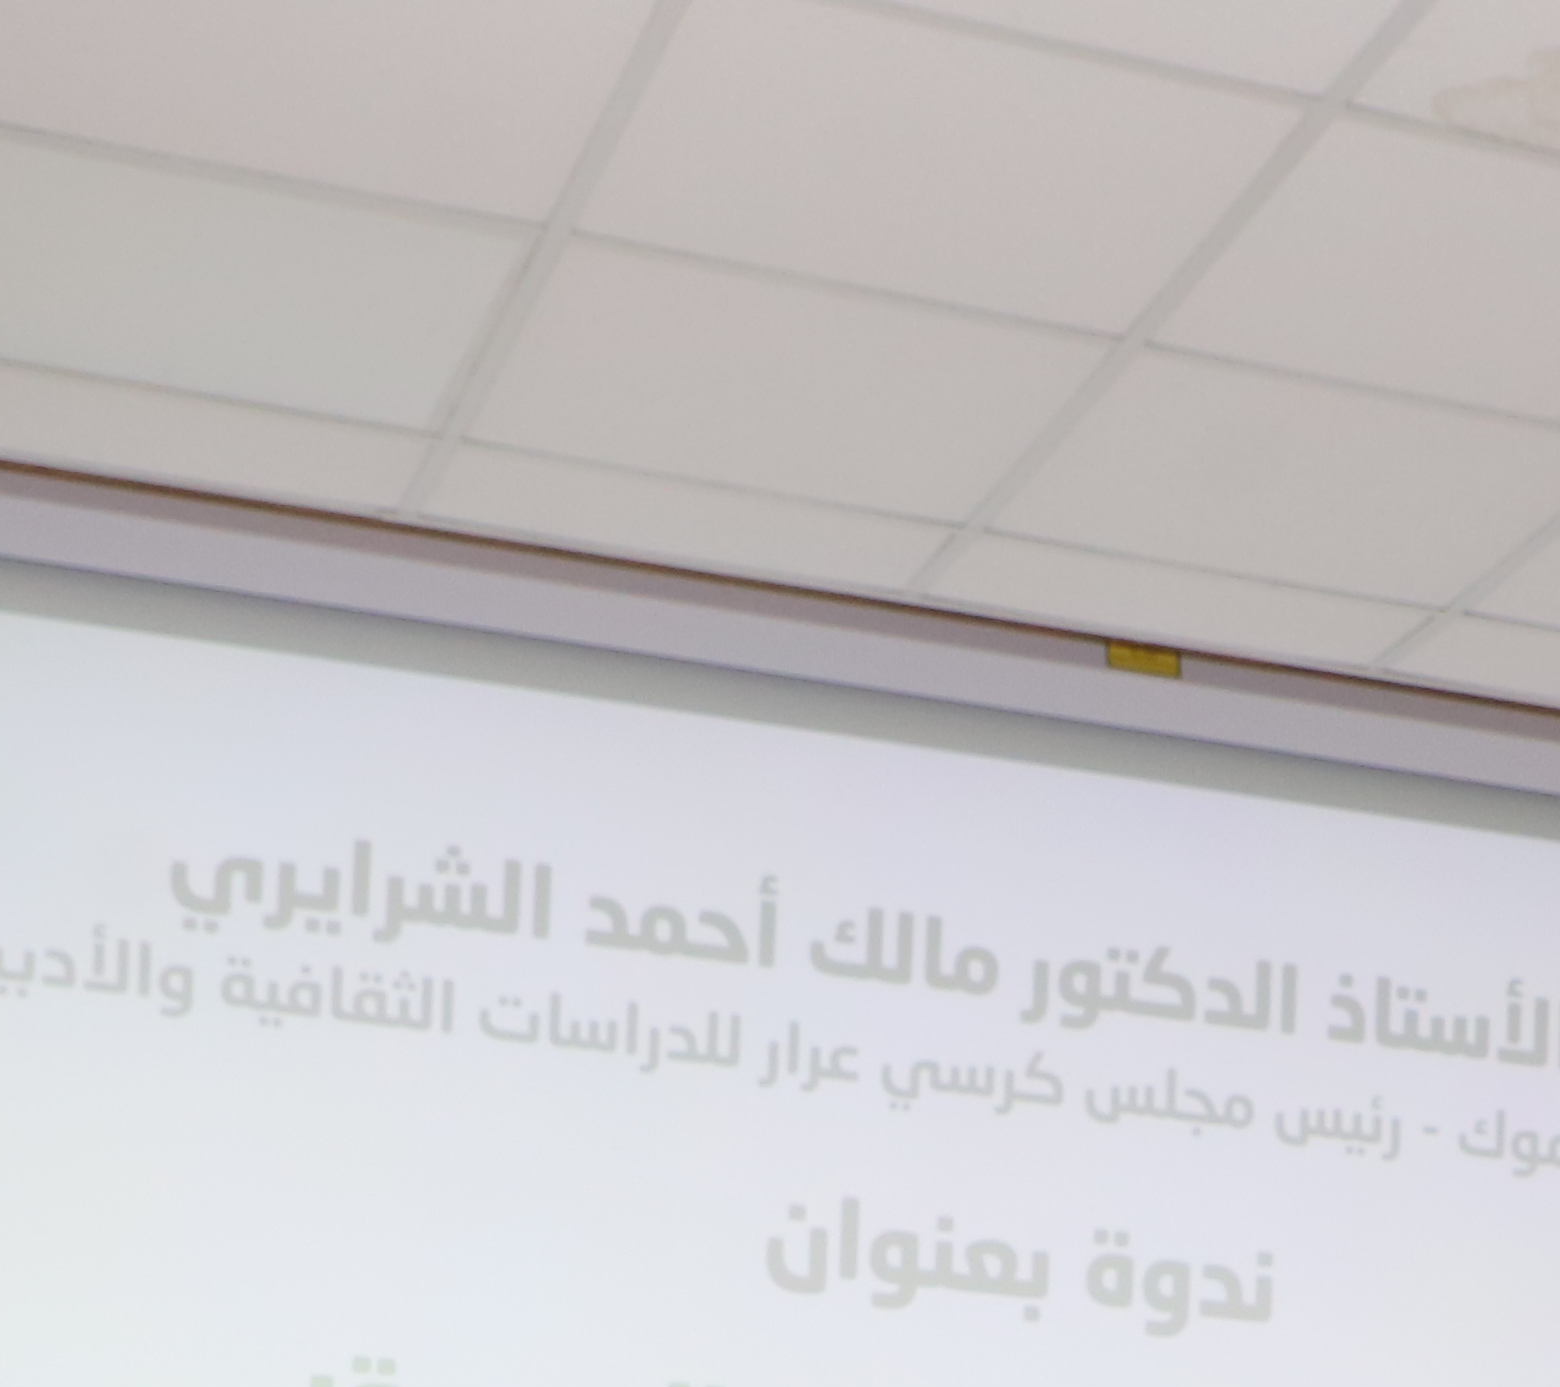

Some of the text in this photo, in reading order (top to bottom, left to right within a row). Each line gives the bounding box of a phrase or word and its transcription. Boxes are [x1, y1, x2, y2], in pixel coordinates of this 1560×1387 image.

[168, 838, 554, 945] الشرايري
[583, 872, 780, 970] أحمد
[807, 905, 1001, 996] مالك
[1017, 943, 1300, 1035] الدكتور
[219, 954, 456, 1035] الثقافية
[477, 990, 743, 1076] للدراسات
[756, 1018, 860, 1094] عرار
[879, 1032, 1065, 1117] كرسي
[1083, 1062, 1256, 1138] مجلس
[1273, 1092, 1403, 1164] رئيس
[764, 1195, 1276, 1339] ندوة بعنوان
